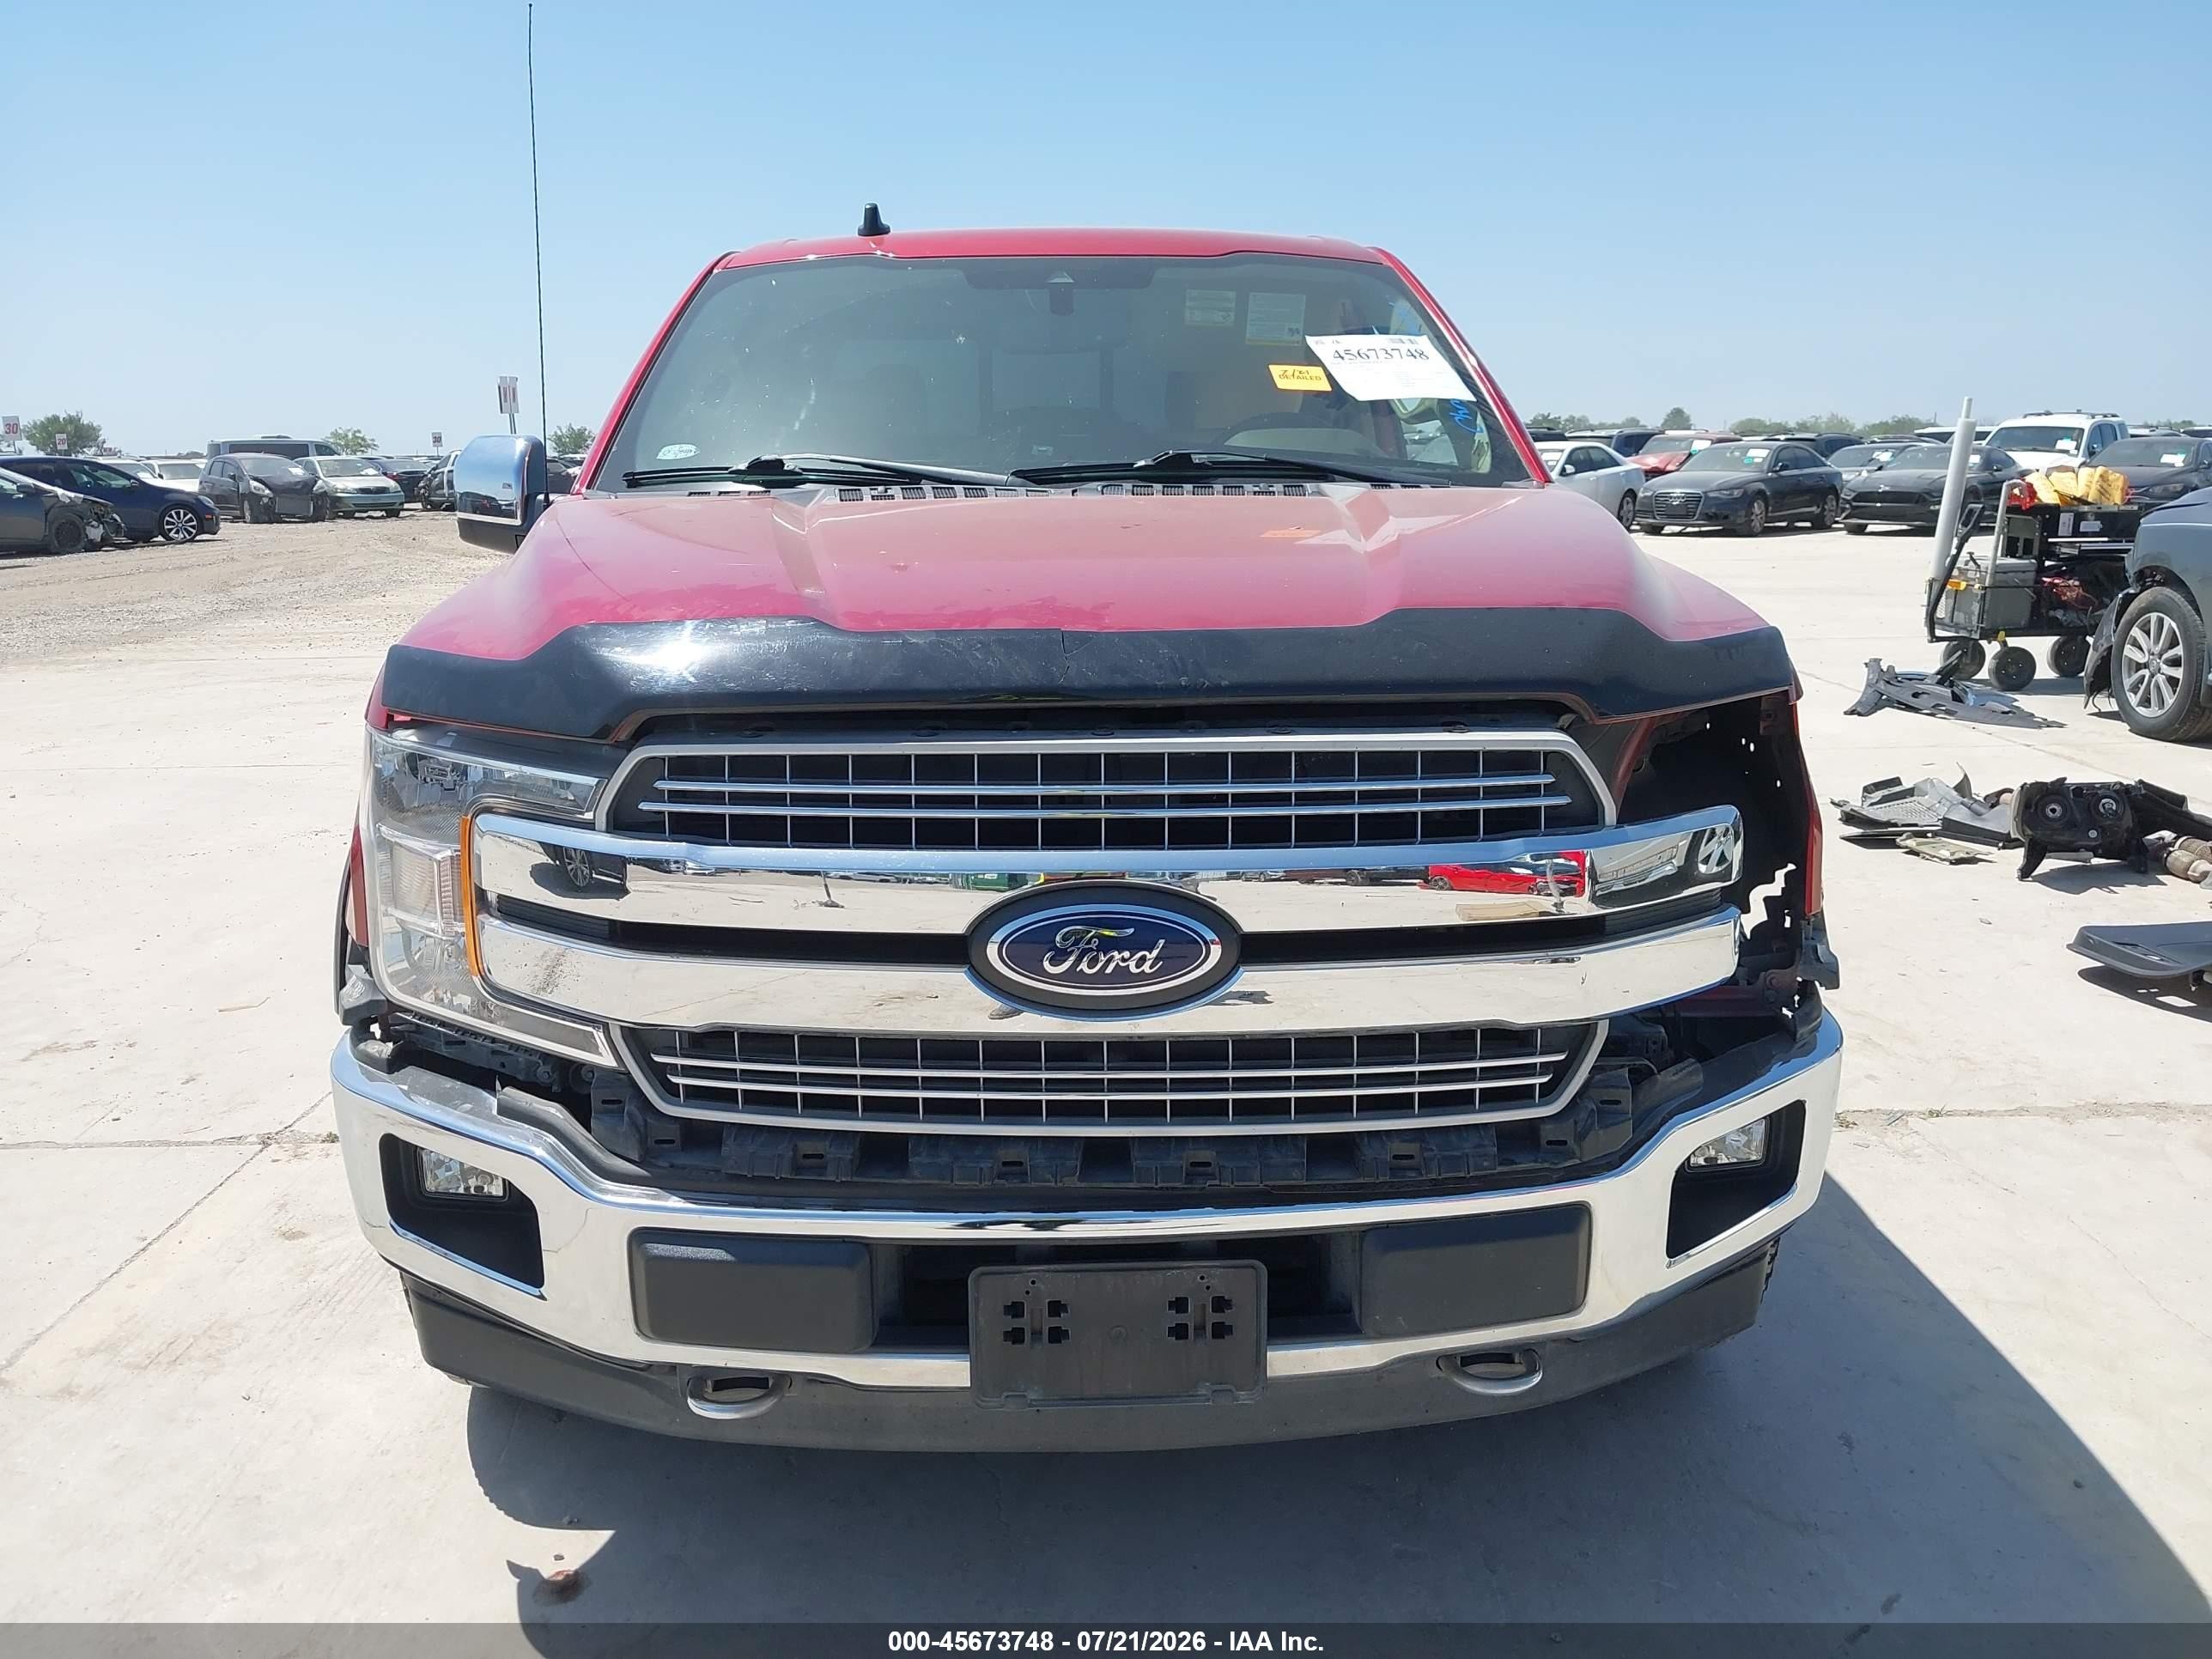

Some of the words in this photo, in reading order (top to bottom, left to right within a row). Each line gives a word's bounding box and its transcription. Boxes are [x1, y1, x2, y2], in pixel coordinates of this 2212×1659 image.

[1333, 348, 1430, 361] 45673748
[5, 422, 19, 434] 30
[1042, 926, 1166, 975] Ford
